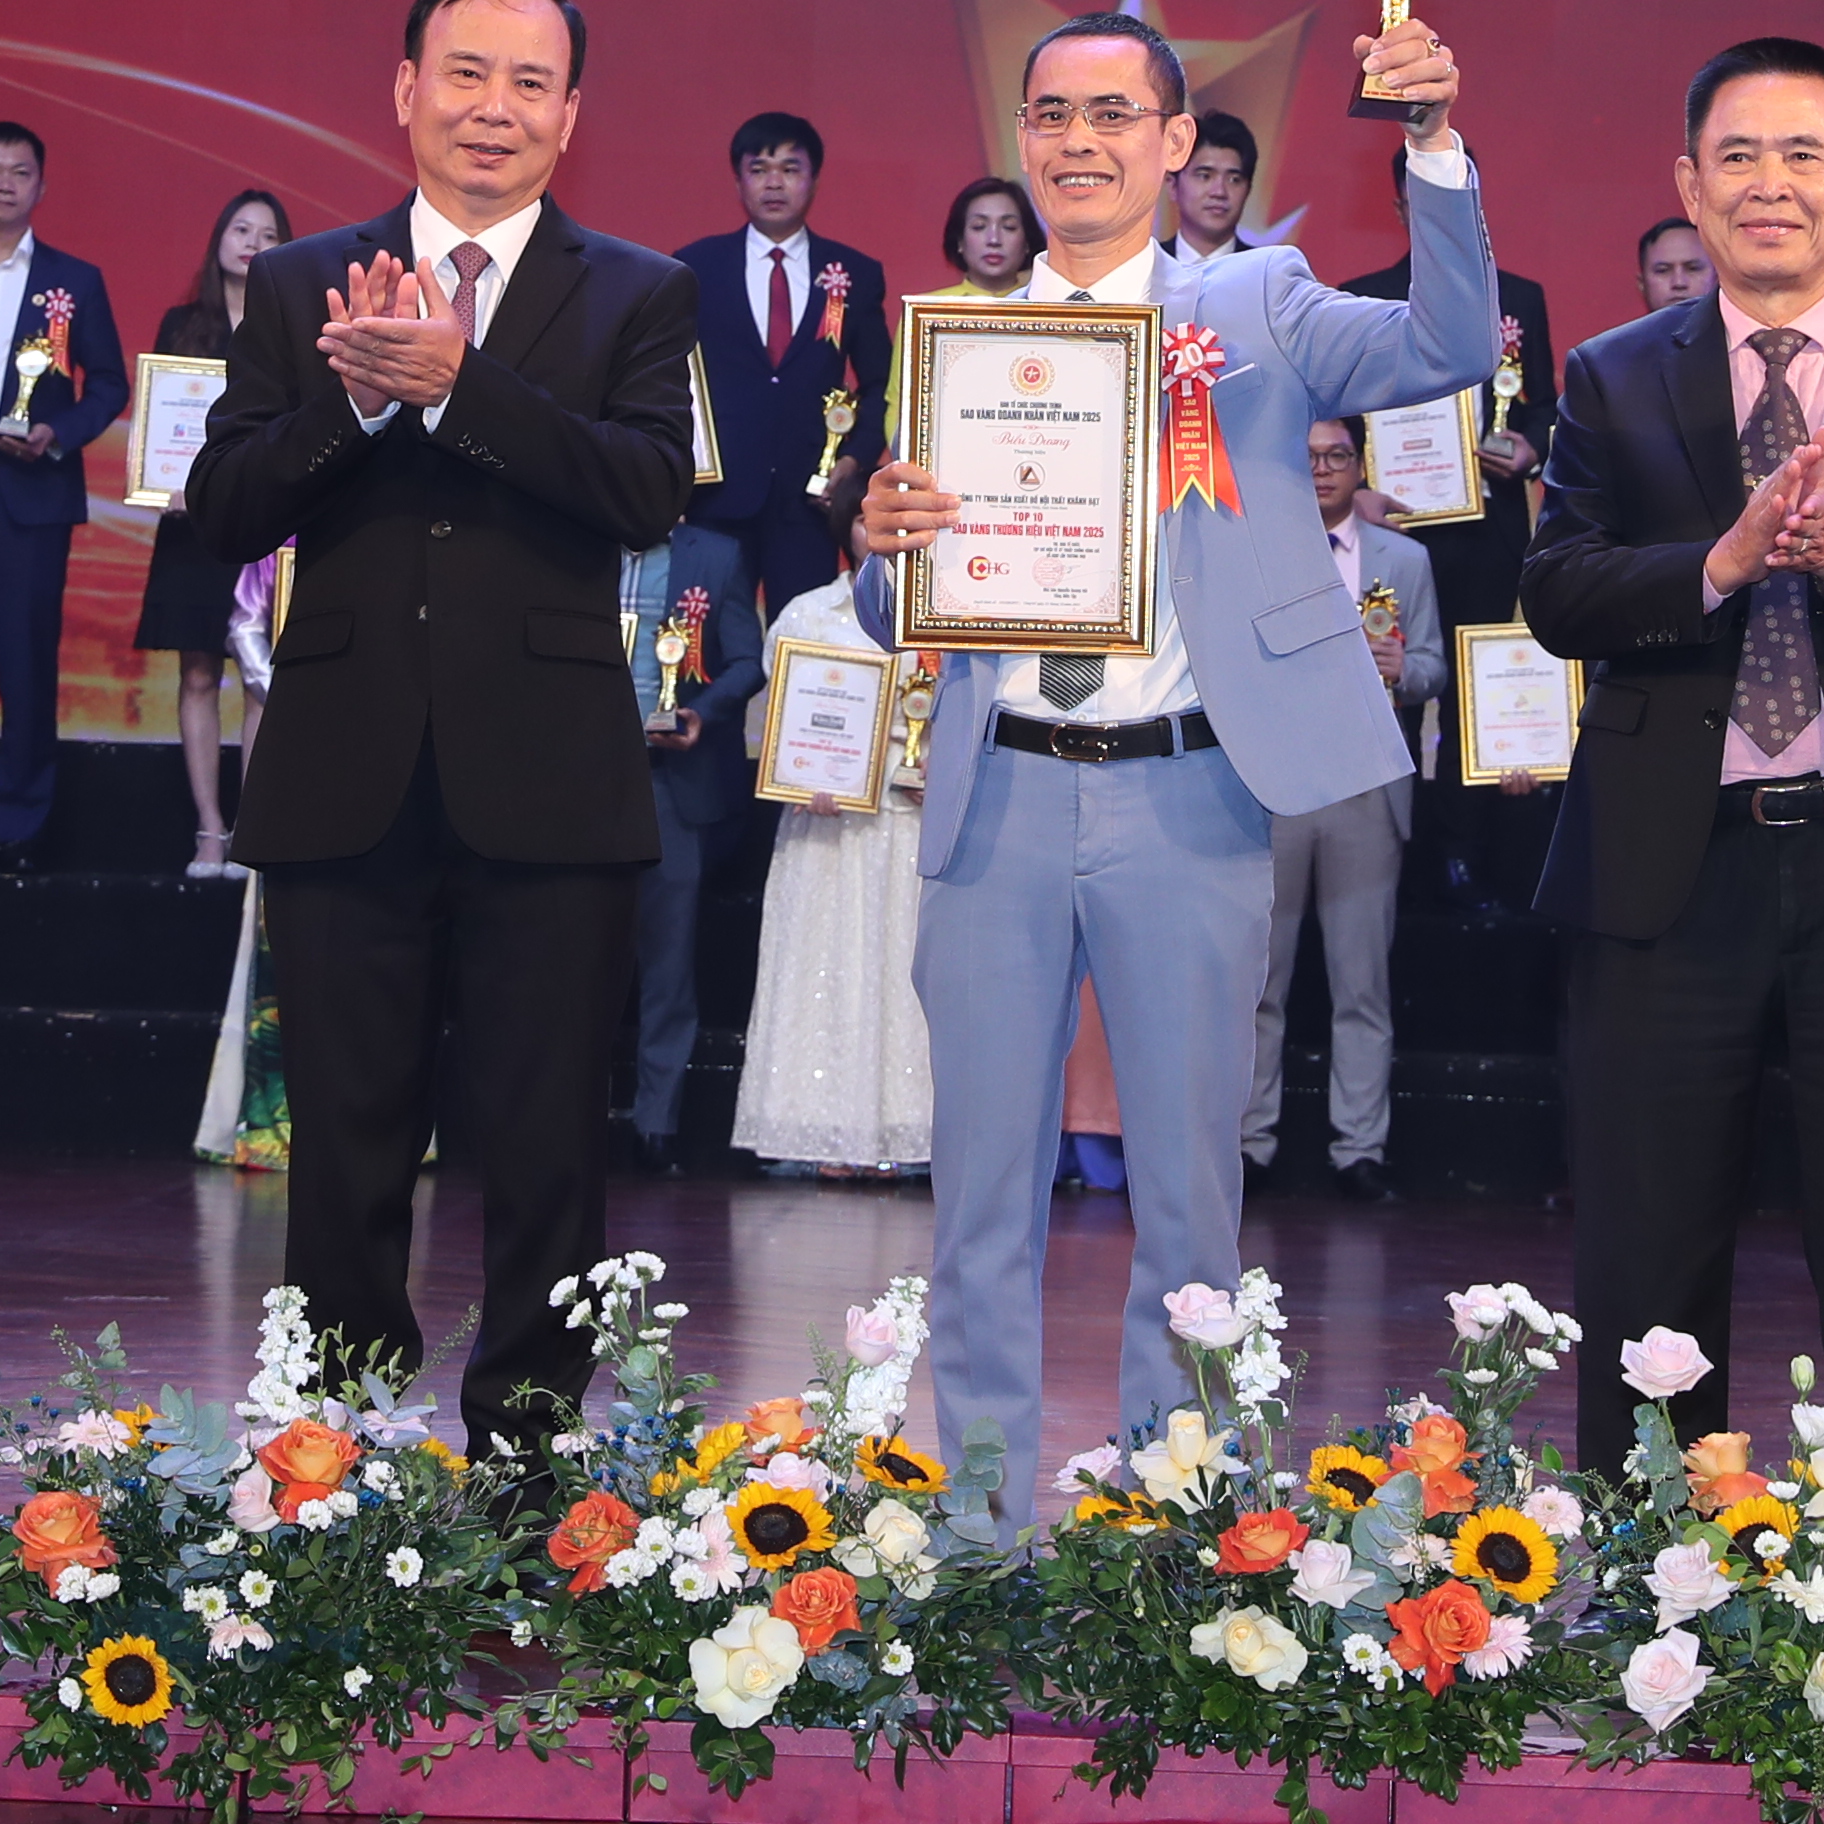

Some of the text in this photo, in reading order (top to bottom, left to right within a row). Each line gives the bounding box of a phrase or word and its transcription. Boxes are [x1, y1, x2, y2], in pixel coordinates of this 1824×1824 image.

[53, 300, 67, 311] 10
[1168, 342, 1204, 376] 20
[960, 408, 1101, 424] SAO VÀNG DOANH NHÂN VIỆT NAM 2025
[1013, 512, 1043, 522] TOP 10
[952, 524, 968, 534] SAO
[970, 522, 990, 535] VÀNG
[993, 524, 1023, 535] THƯƠNG
[1063, 527, 1081, 537] NAM
[1083, 527, 1104, 538] 2025
[689, 600, 703, 613] 17
